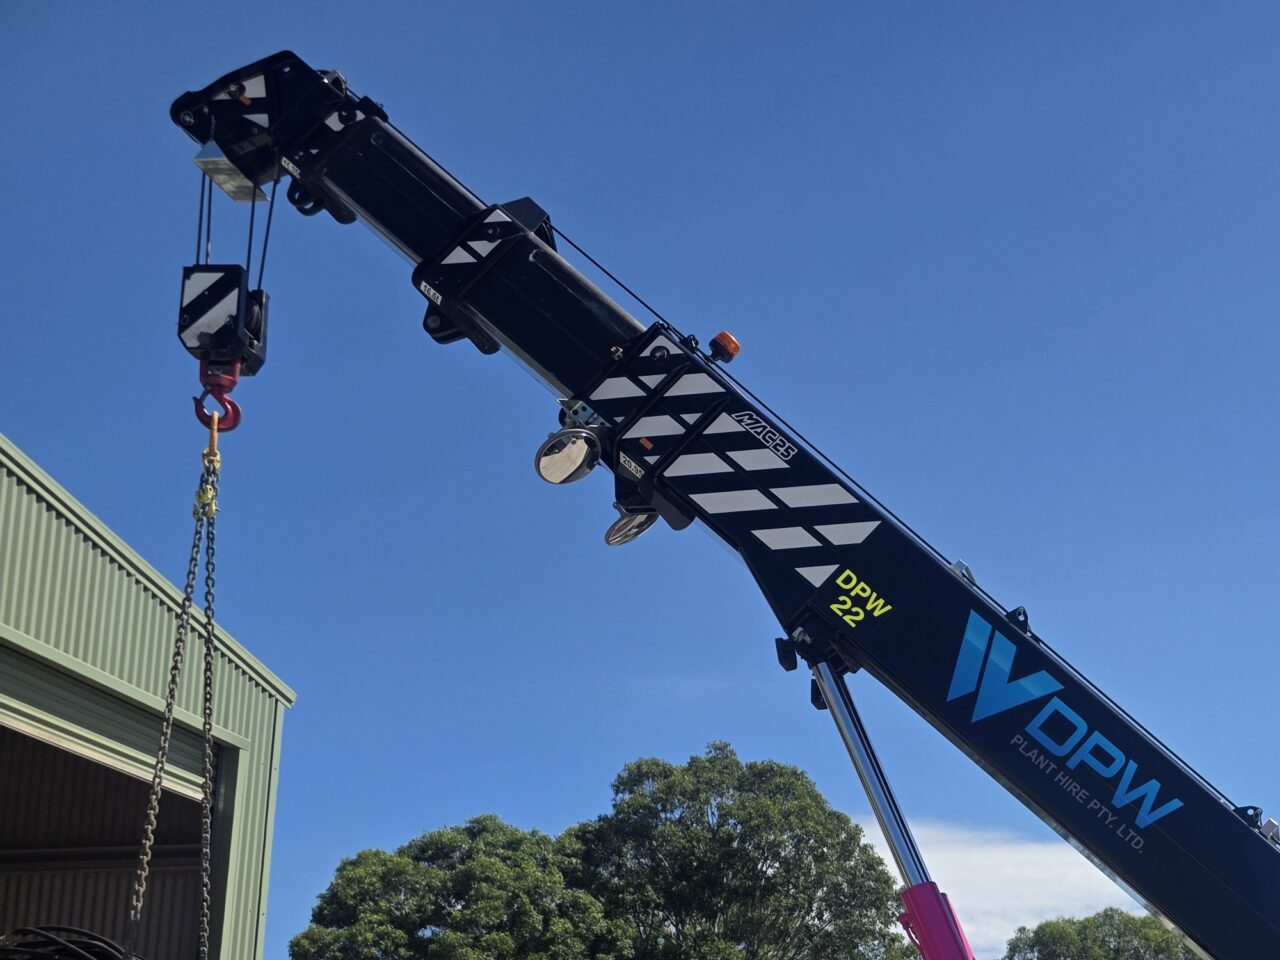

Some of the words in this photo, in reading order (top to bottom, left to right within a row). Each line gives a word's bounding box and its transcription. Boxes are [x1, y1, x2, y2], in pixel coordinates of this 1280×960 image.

[731, 411, 799, 461] MAC25
[830, 595, 865, 628] 22
[836, 569, 893, 617] DPW
[1025, 696, 1184, 829] DPW
[1010, 734, 1058, 775] PLANT
[1054, 771, 1090, 804] HIRE
[1087, 799, 1118, 828] PTY.
[1116, 824, 1145, 854] LTD.
